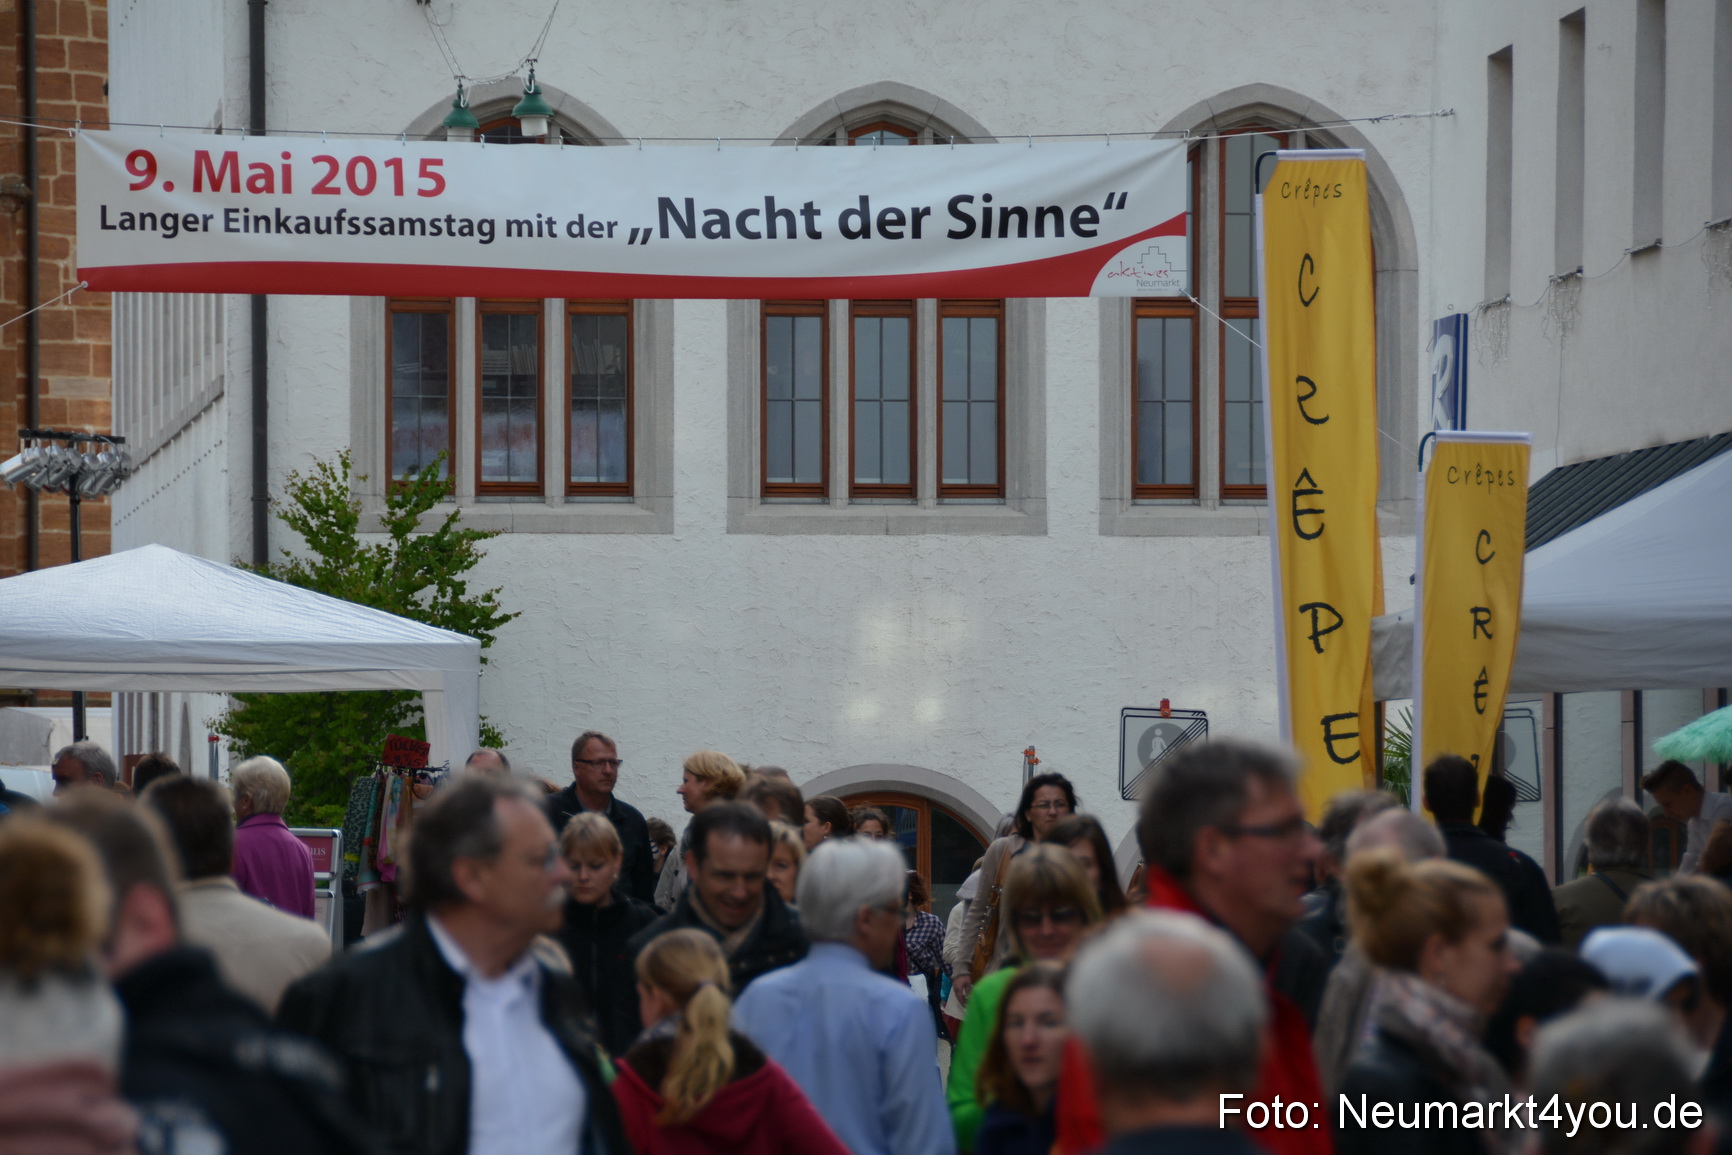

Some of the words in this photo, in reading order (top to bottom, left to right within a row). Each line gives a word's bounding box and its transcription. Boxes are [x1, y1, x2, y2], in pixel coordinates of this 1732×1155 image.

[124, 148, 175, 193] 9.
[192, 149, 293, 195] Mai
[310, 154, 447, 198] 2015
[1281, 178, 1343, 208] Crêpes
[100, 204, 214, 239] Langer
[223, 207, 496, 245] Einkaufssamstag
[505, 211, 557, 238] mit
[566, 211, 618, 239] der
[838, 194, 931, 240] der
[1136, 279, 1180, 288] Neumarkt
[1447, 462, 1516, 495] Crêpes
